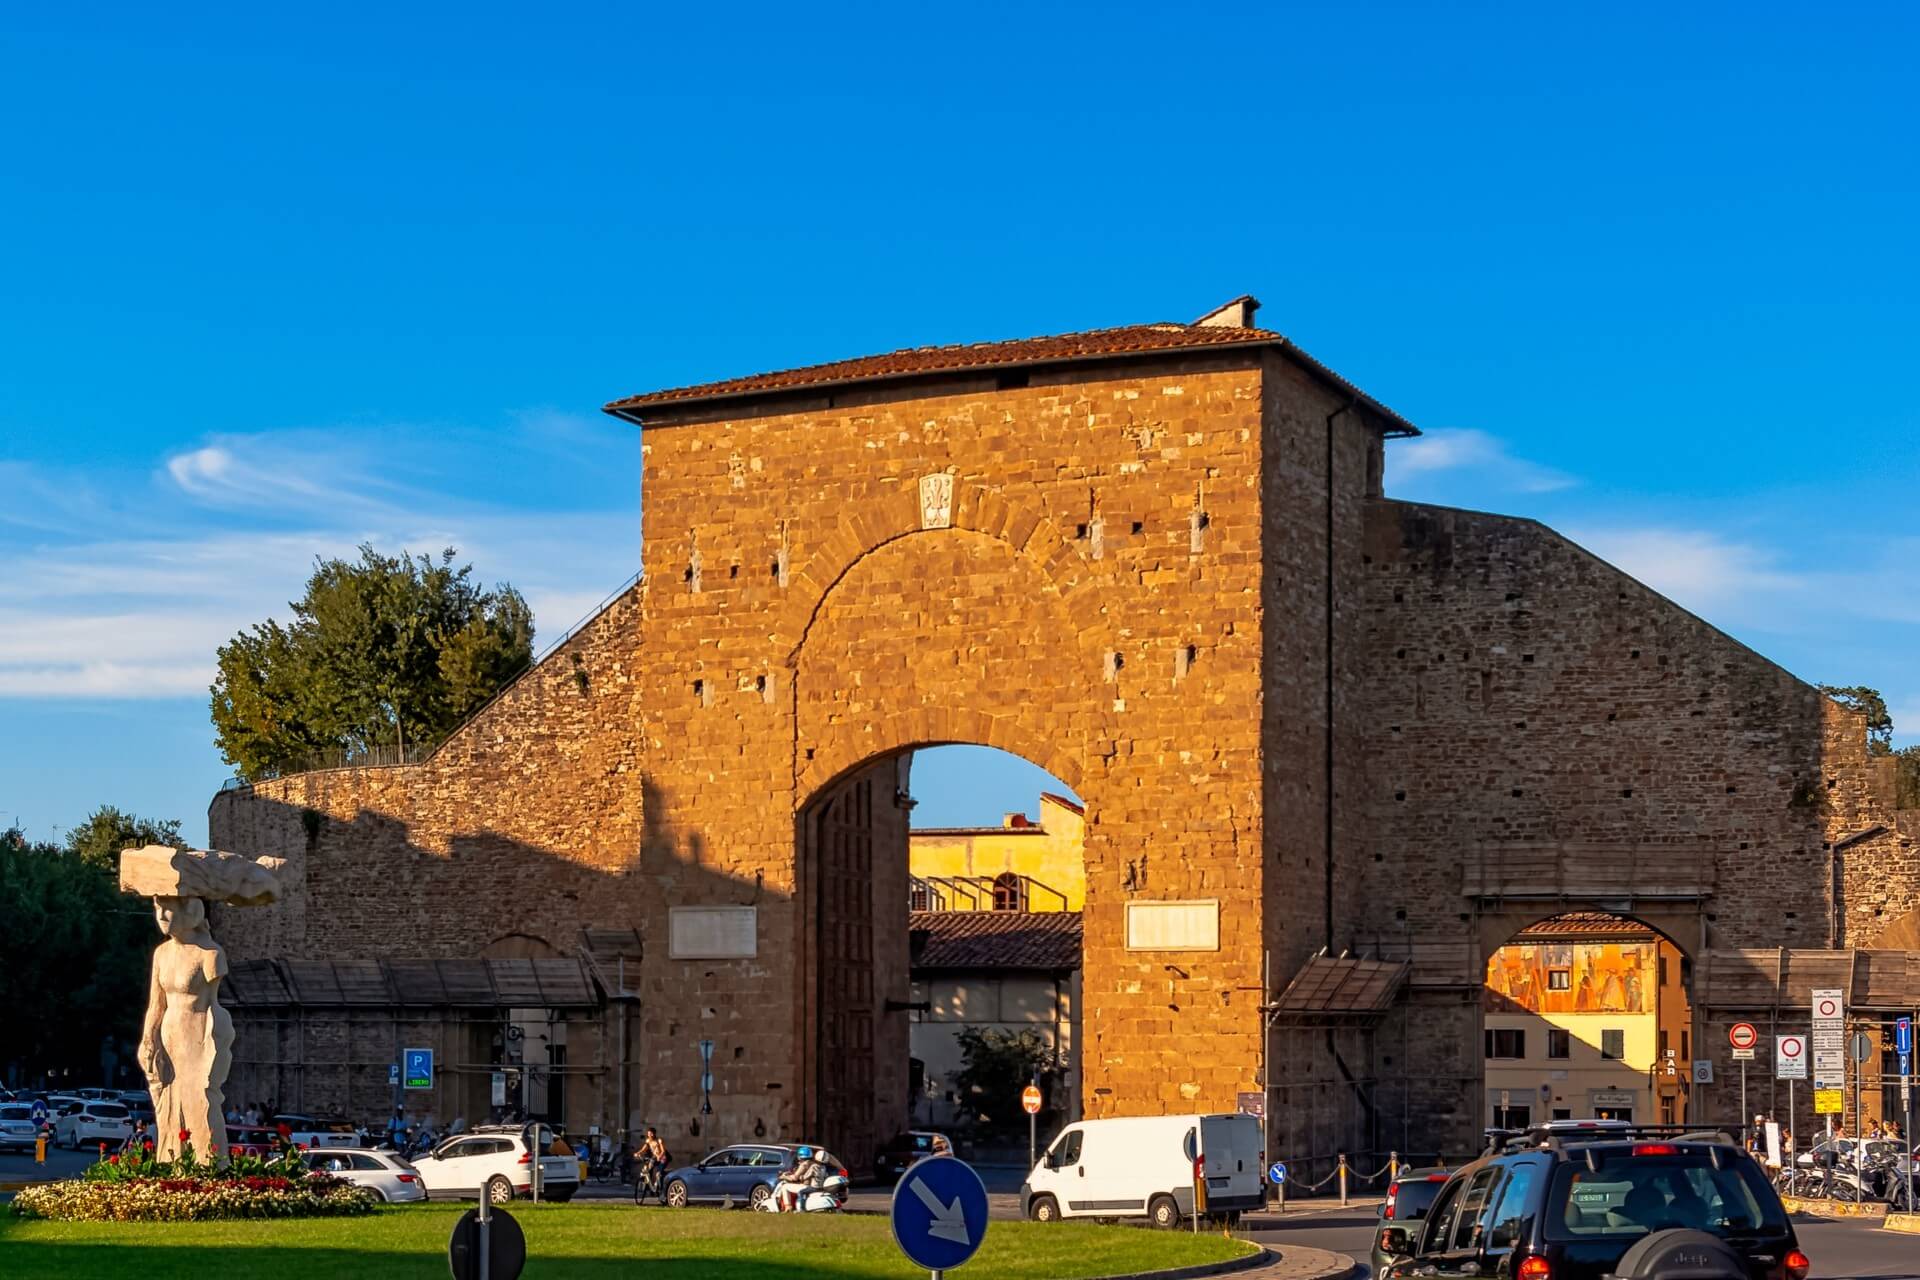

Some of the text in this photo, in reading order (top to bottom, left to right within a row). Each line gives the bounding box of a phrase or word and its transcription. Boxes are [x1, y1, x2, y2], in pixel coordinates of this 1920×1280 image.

[414, 1056, 423, 1066] P
[1667, 1049, 1675, 1075] BAR
[1901, 1056, 1907, 1074] P
[391, 1065, 399, 1077] P
